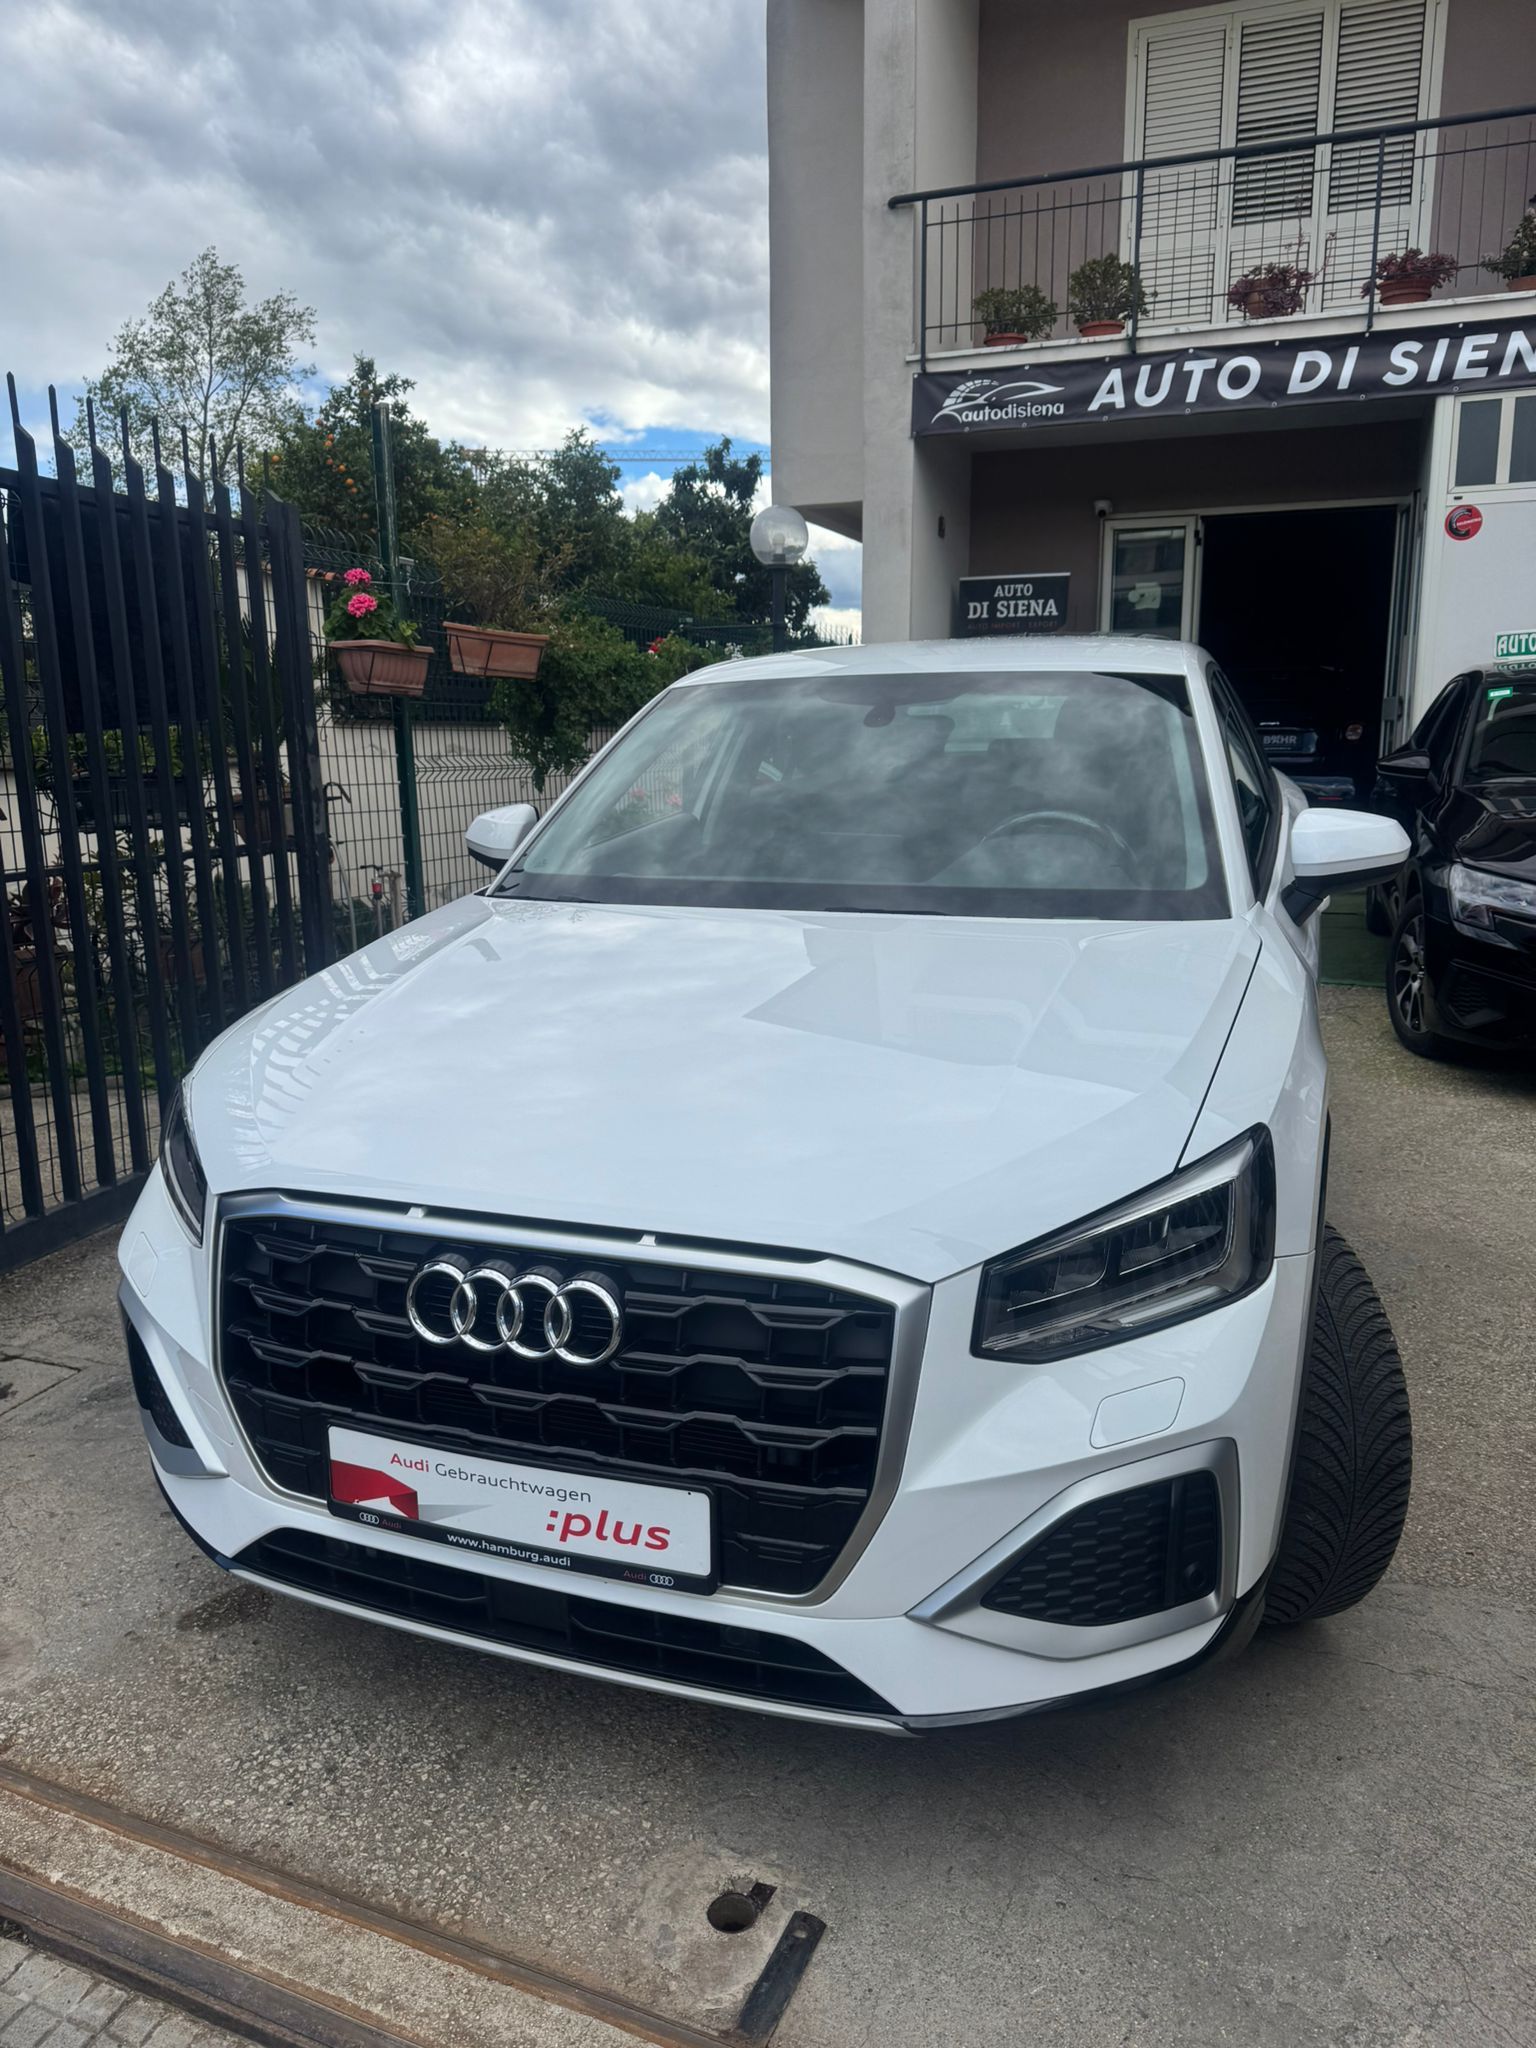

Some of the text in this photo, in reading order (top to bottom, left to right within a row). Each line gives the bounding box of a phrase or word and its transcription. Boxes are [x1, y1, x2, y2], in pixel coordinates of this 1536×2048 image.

[1087, 329, 1536, 412] AUTO DI SIEN
[961, 402, 1065, 423] autodisiena
[993, 583, 1033, 598] AUTO
[967, 598, 1059, 619] DI SIENA
[390, 1453, 592, 1503] Audi Gebrauchtwagen
[381, 1518, 402, 1529] Audi
[546, 1509, 671, 1551] :plus
[446, 1533, 572, 1567] www.hamburg.audi
[623, 1569, 647, 1581] Audi
